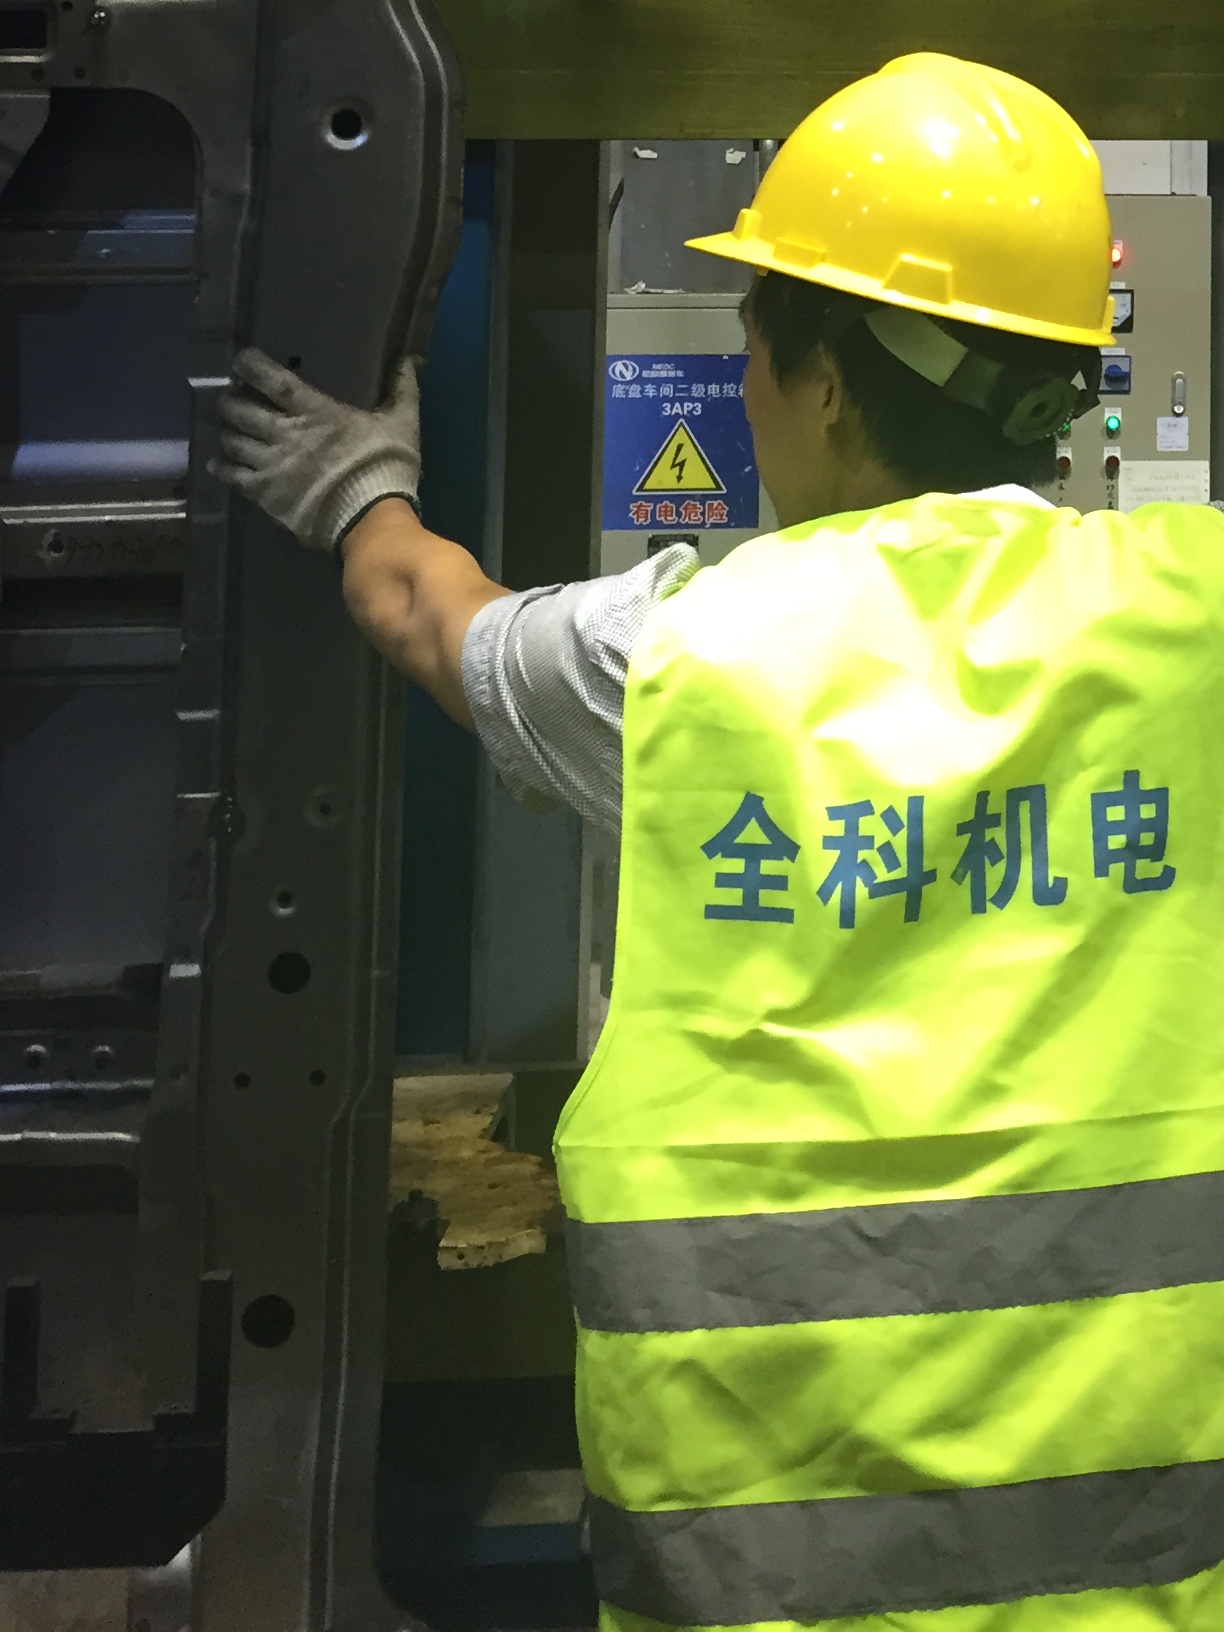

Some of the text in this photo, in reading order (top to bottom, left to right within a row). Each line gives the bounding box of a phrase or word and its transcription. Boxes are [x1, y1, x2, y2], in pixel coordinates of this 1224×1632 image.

[611, 382, 743, 399] 底盘车间二级电控
[662, 402, 702, 416] 3AP3
[628, 500, 728, 525] 有电危险
[700, 769, 1177, 929] 全科机电
